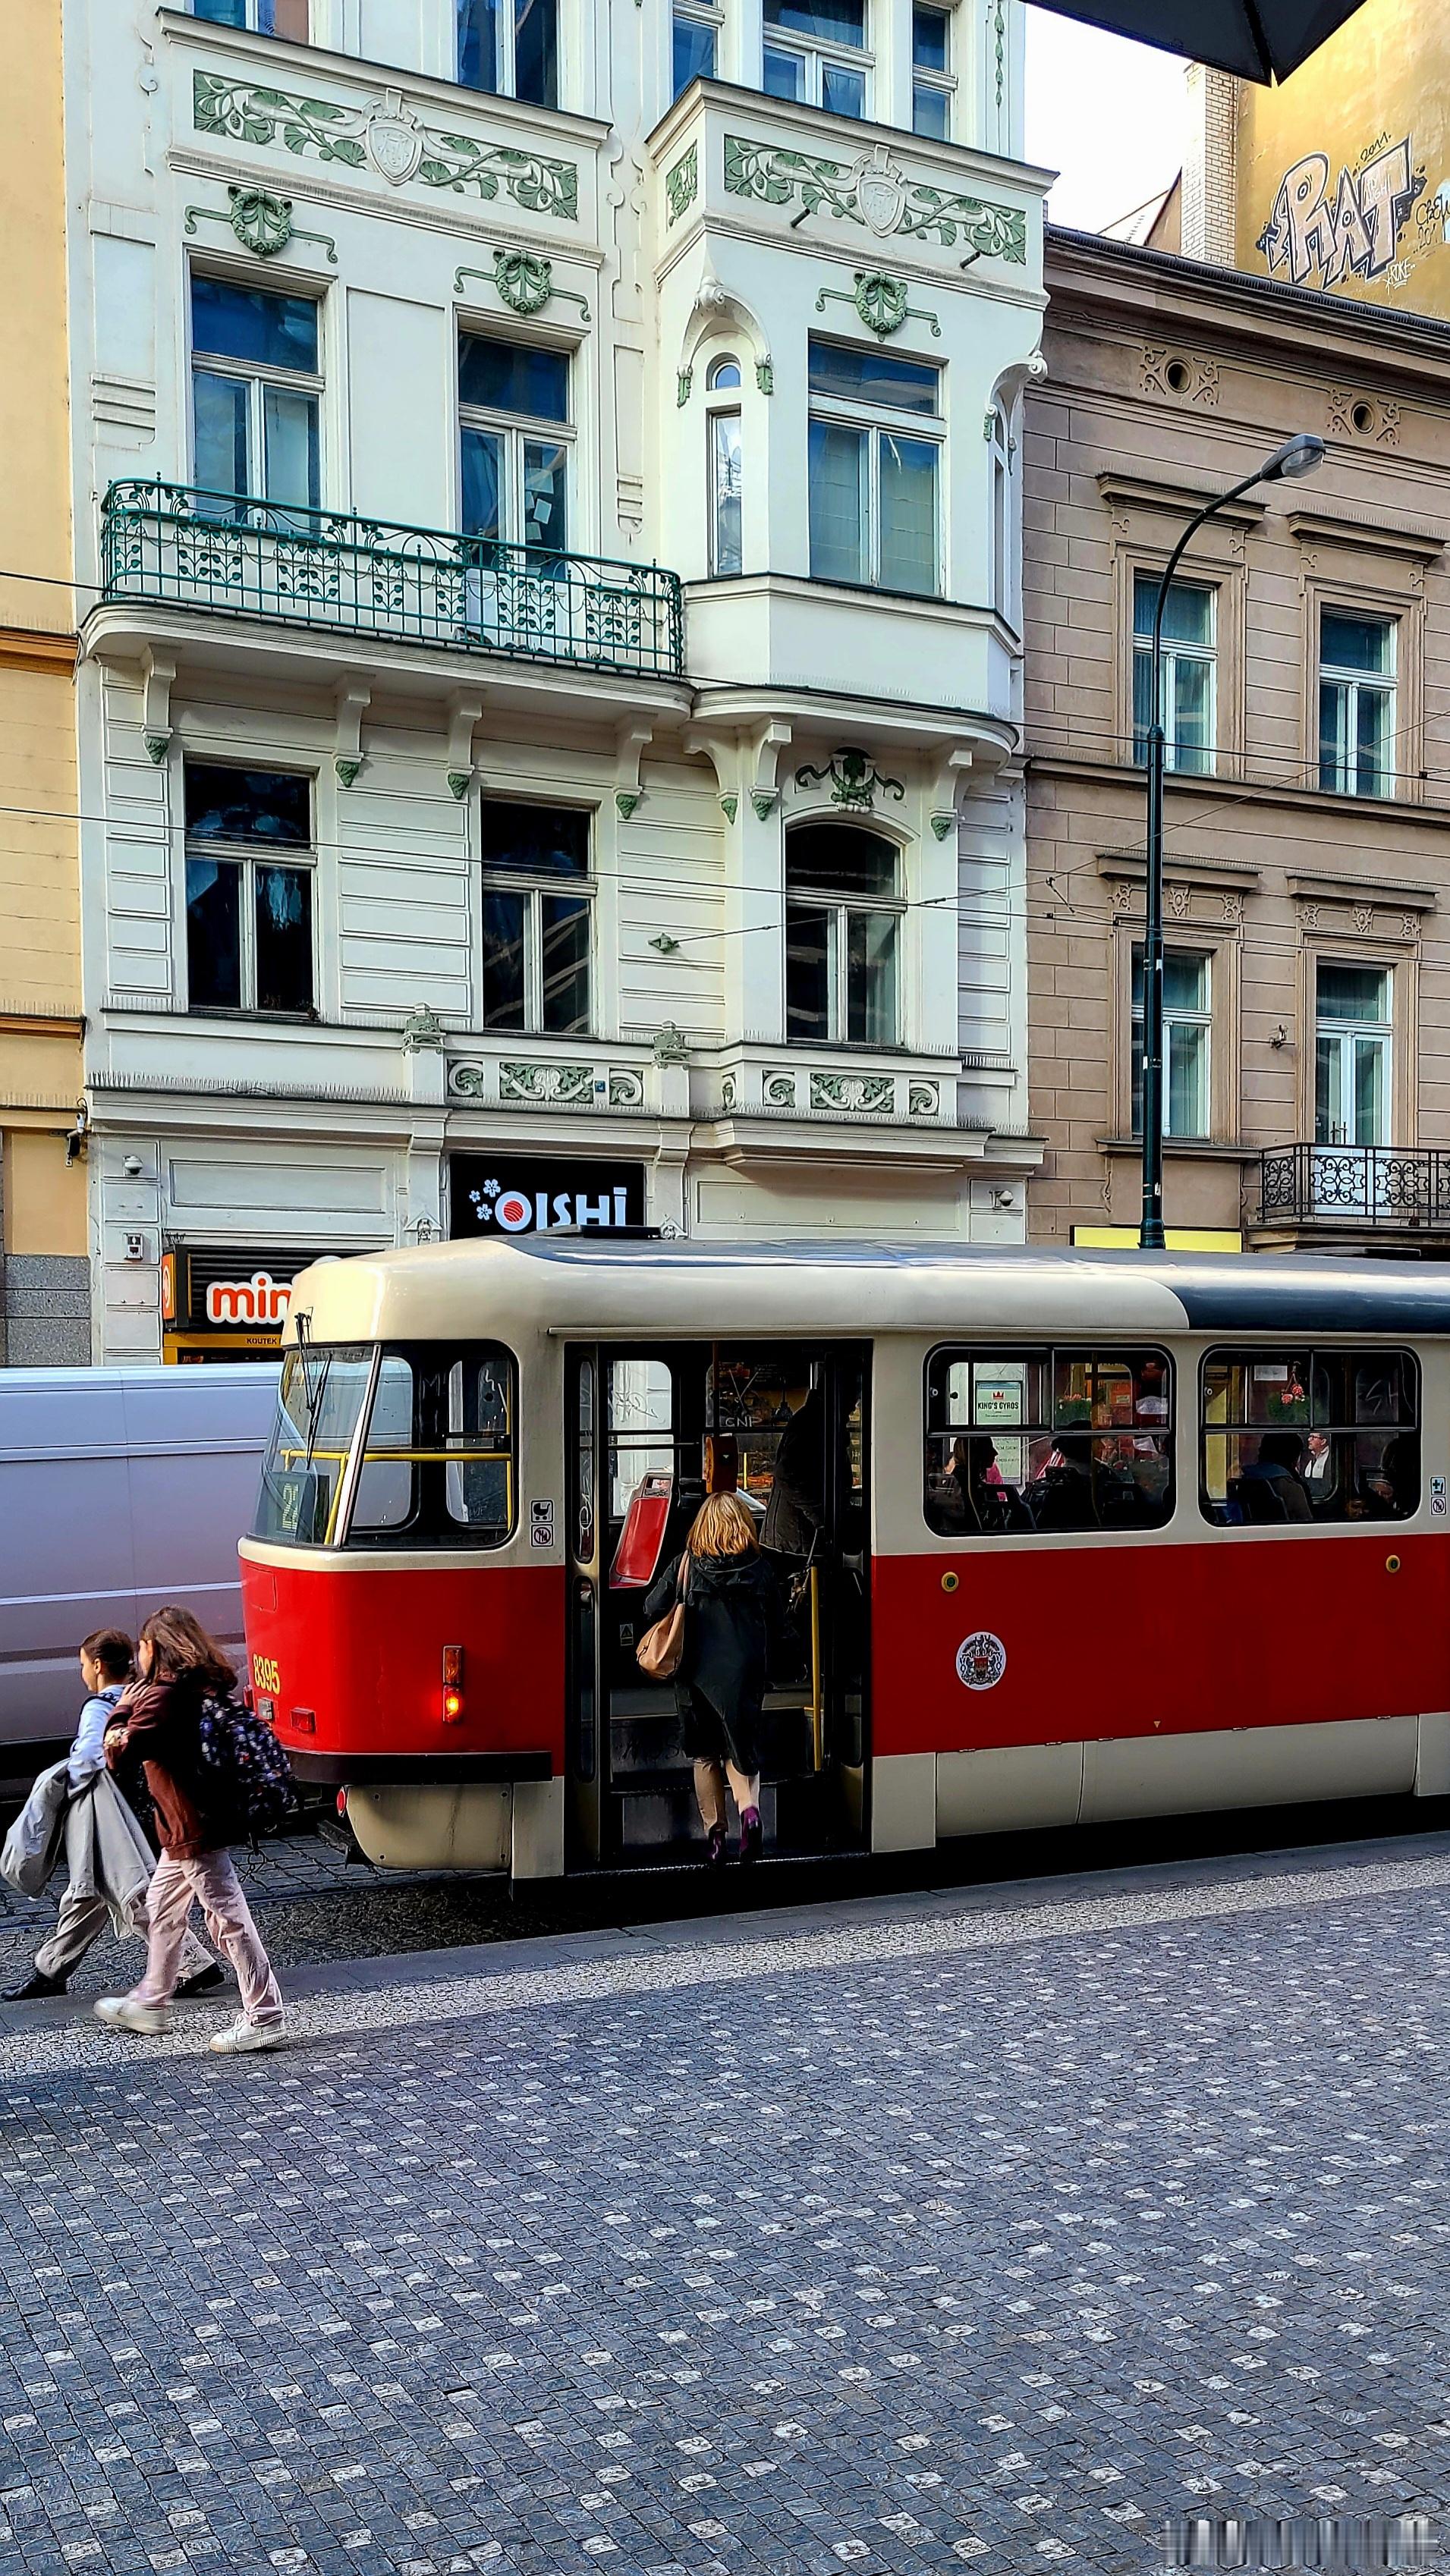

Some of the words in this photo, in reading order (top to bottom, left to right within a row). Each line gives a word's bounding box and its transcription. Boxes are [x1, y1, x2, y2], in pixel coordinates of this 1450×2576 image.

[1267, 132, 1412, 290] RAT
[212, 1277, 292, 1318] min
[253, 1653, 280, 1695] 8395
